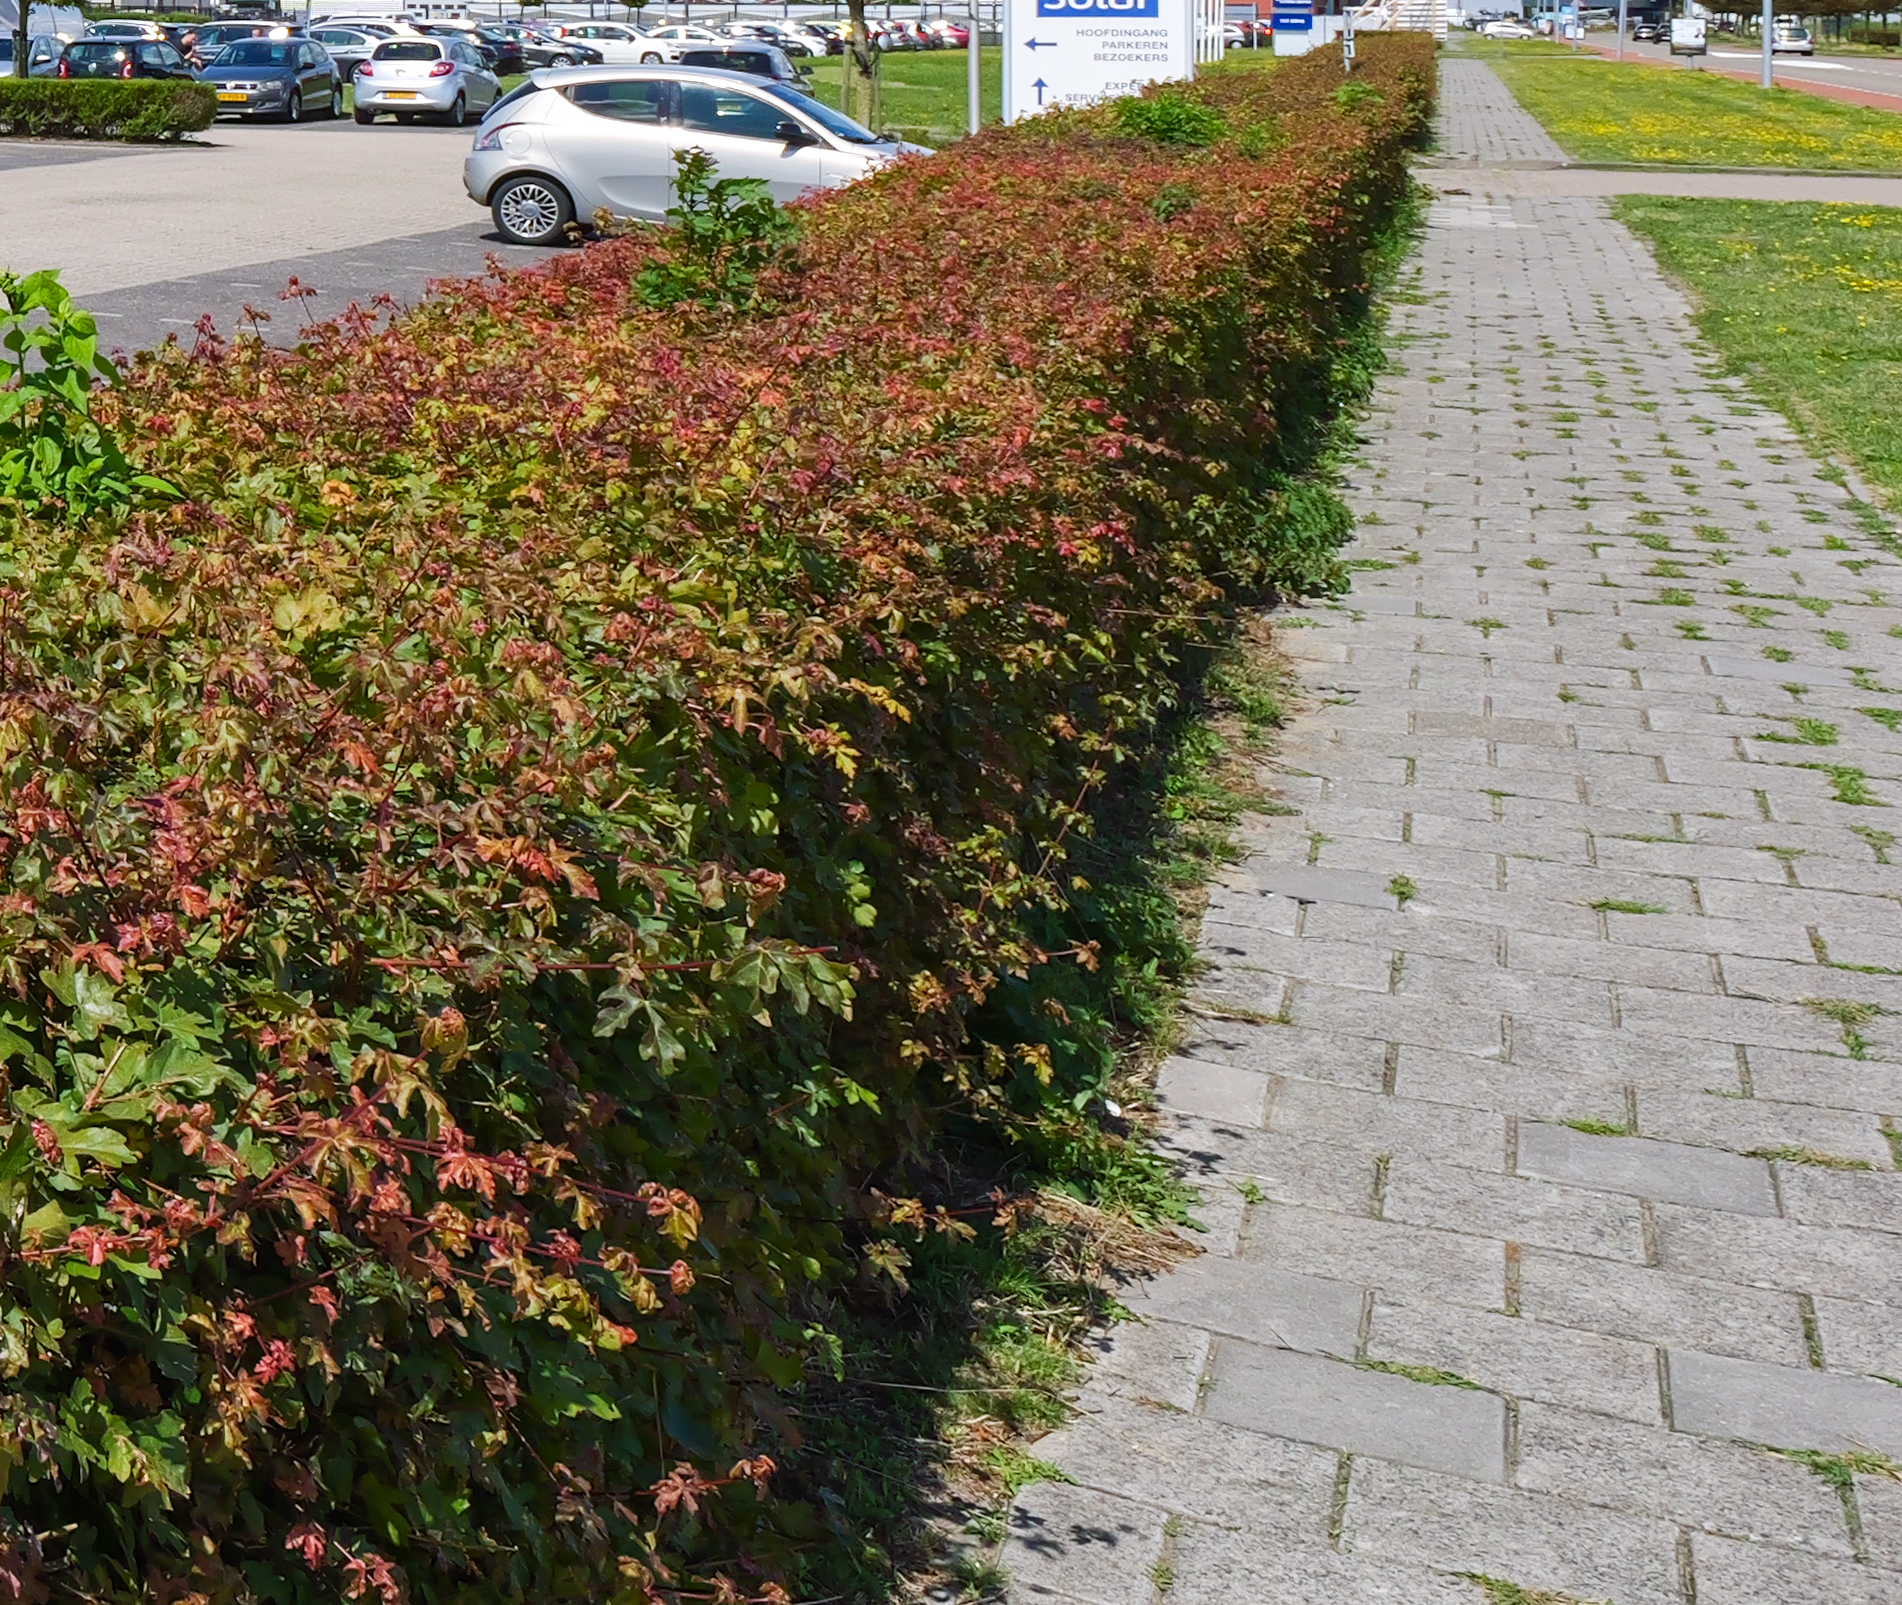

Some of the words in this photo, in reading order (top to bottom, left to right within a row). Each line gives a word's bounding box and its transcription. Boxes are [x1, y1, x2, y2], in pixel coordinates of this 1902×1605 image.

[1076, 29, 1169, 37] HOOFDINGANG
[1102, 41, 1169, 49] PARKEREN
[1093, 53, 1169, 62] BEZOEKERS
